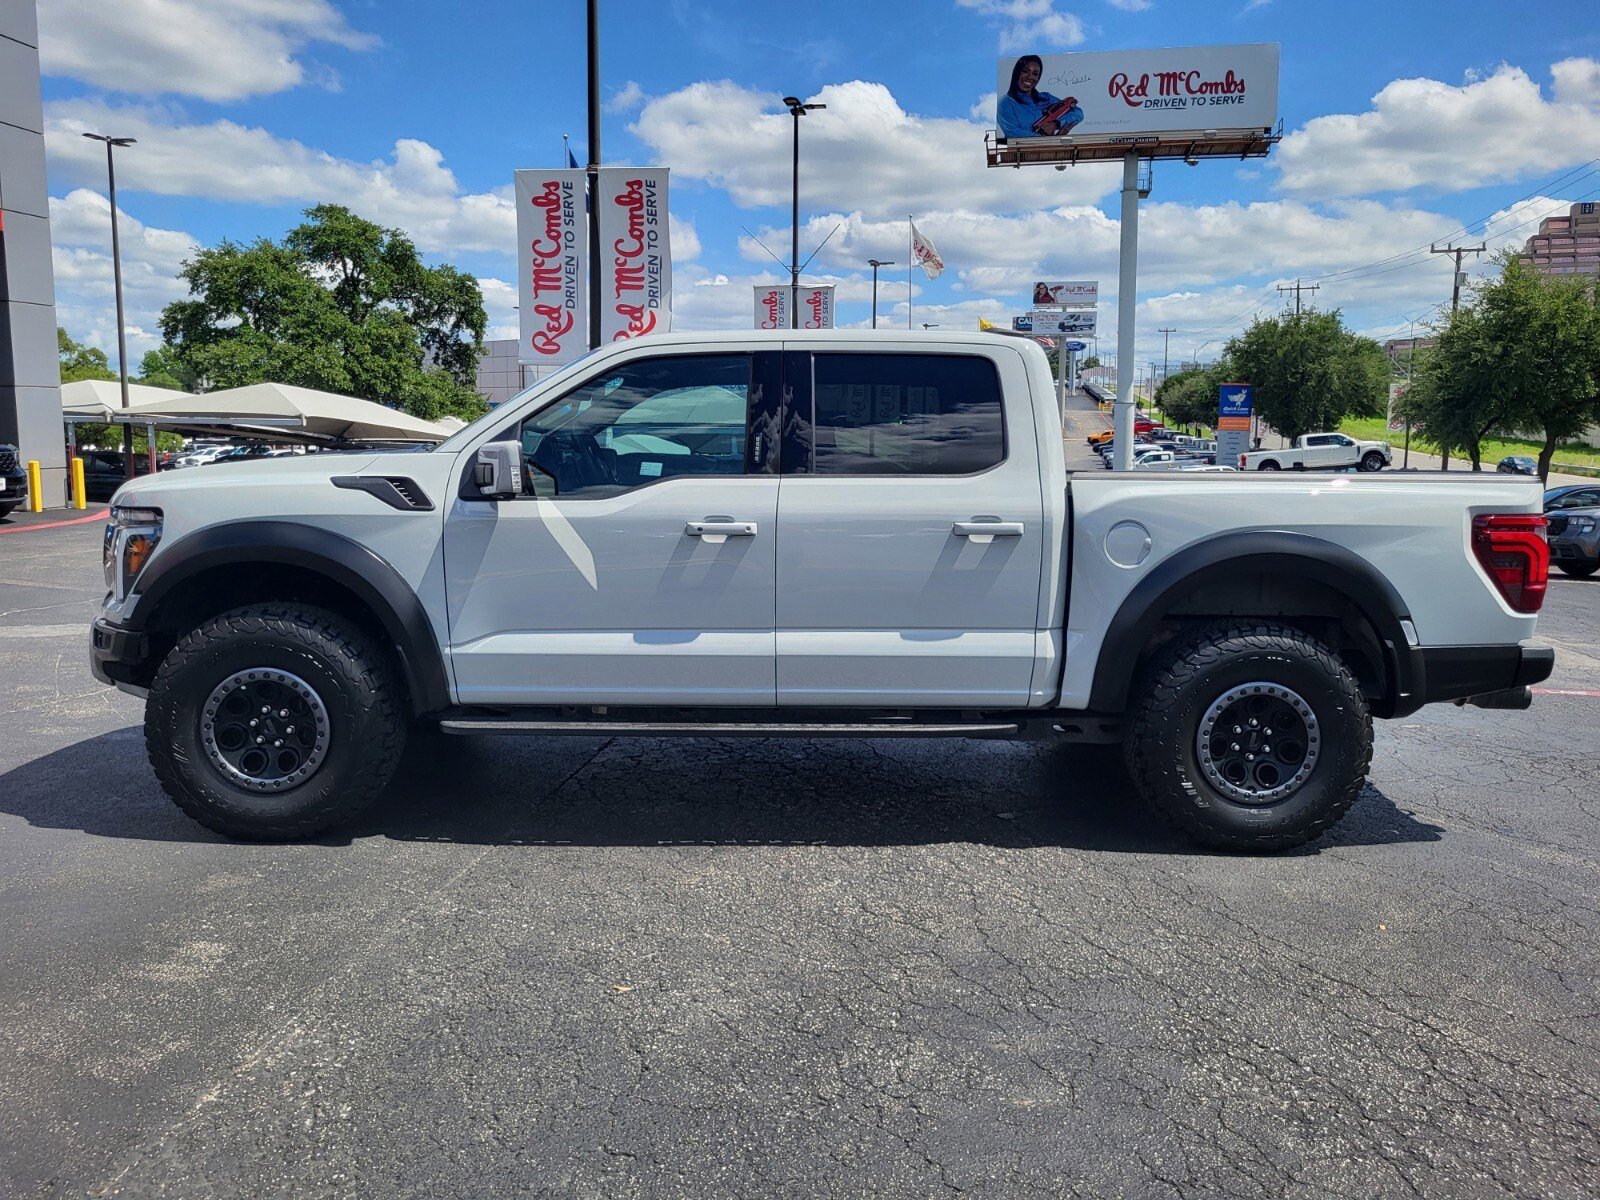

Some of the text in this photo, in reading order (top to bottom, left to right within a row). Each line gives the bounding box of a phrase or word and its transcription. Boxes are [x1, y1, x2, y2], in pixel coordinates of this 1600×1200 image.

[1108, 72, 1150, 107] Red
[1152, 69, 1246, 97] McCombs
[1144, 95, 1245, 109] DRIVEN TO SERVE
[531, 180, 574, 355] Red McCombs
[562, 181, 576, 309] DRIVEN TO SERVE
[614, 179, 645, 300] McCombs
[645, 179, 659, 309] DRIVEN TO SERVE
[779, 317, 784, 327] TO
[823, 317, 828, 326] TO
